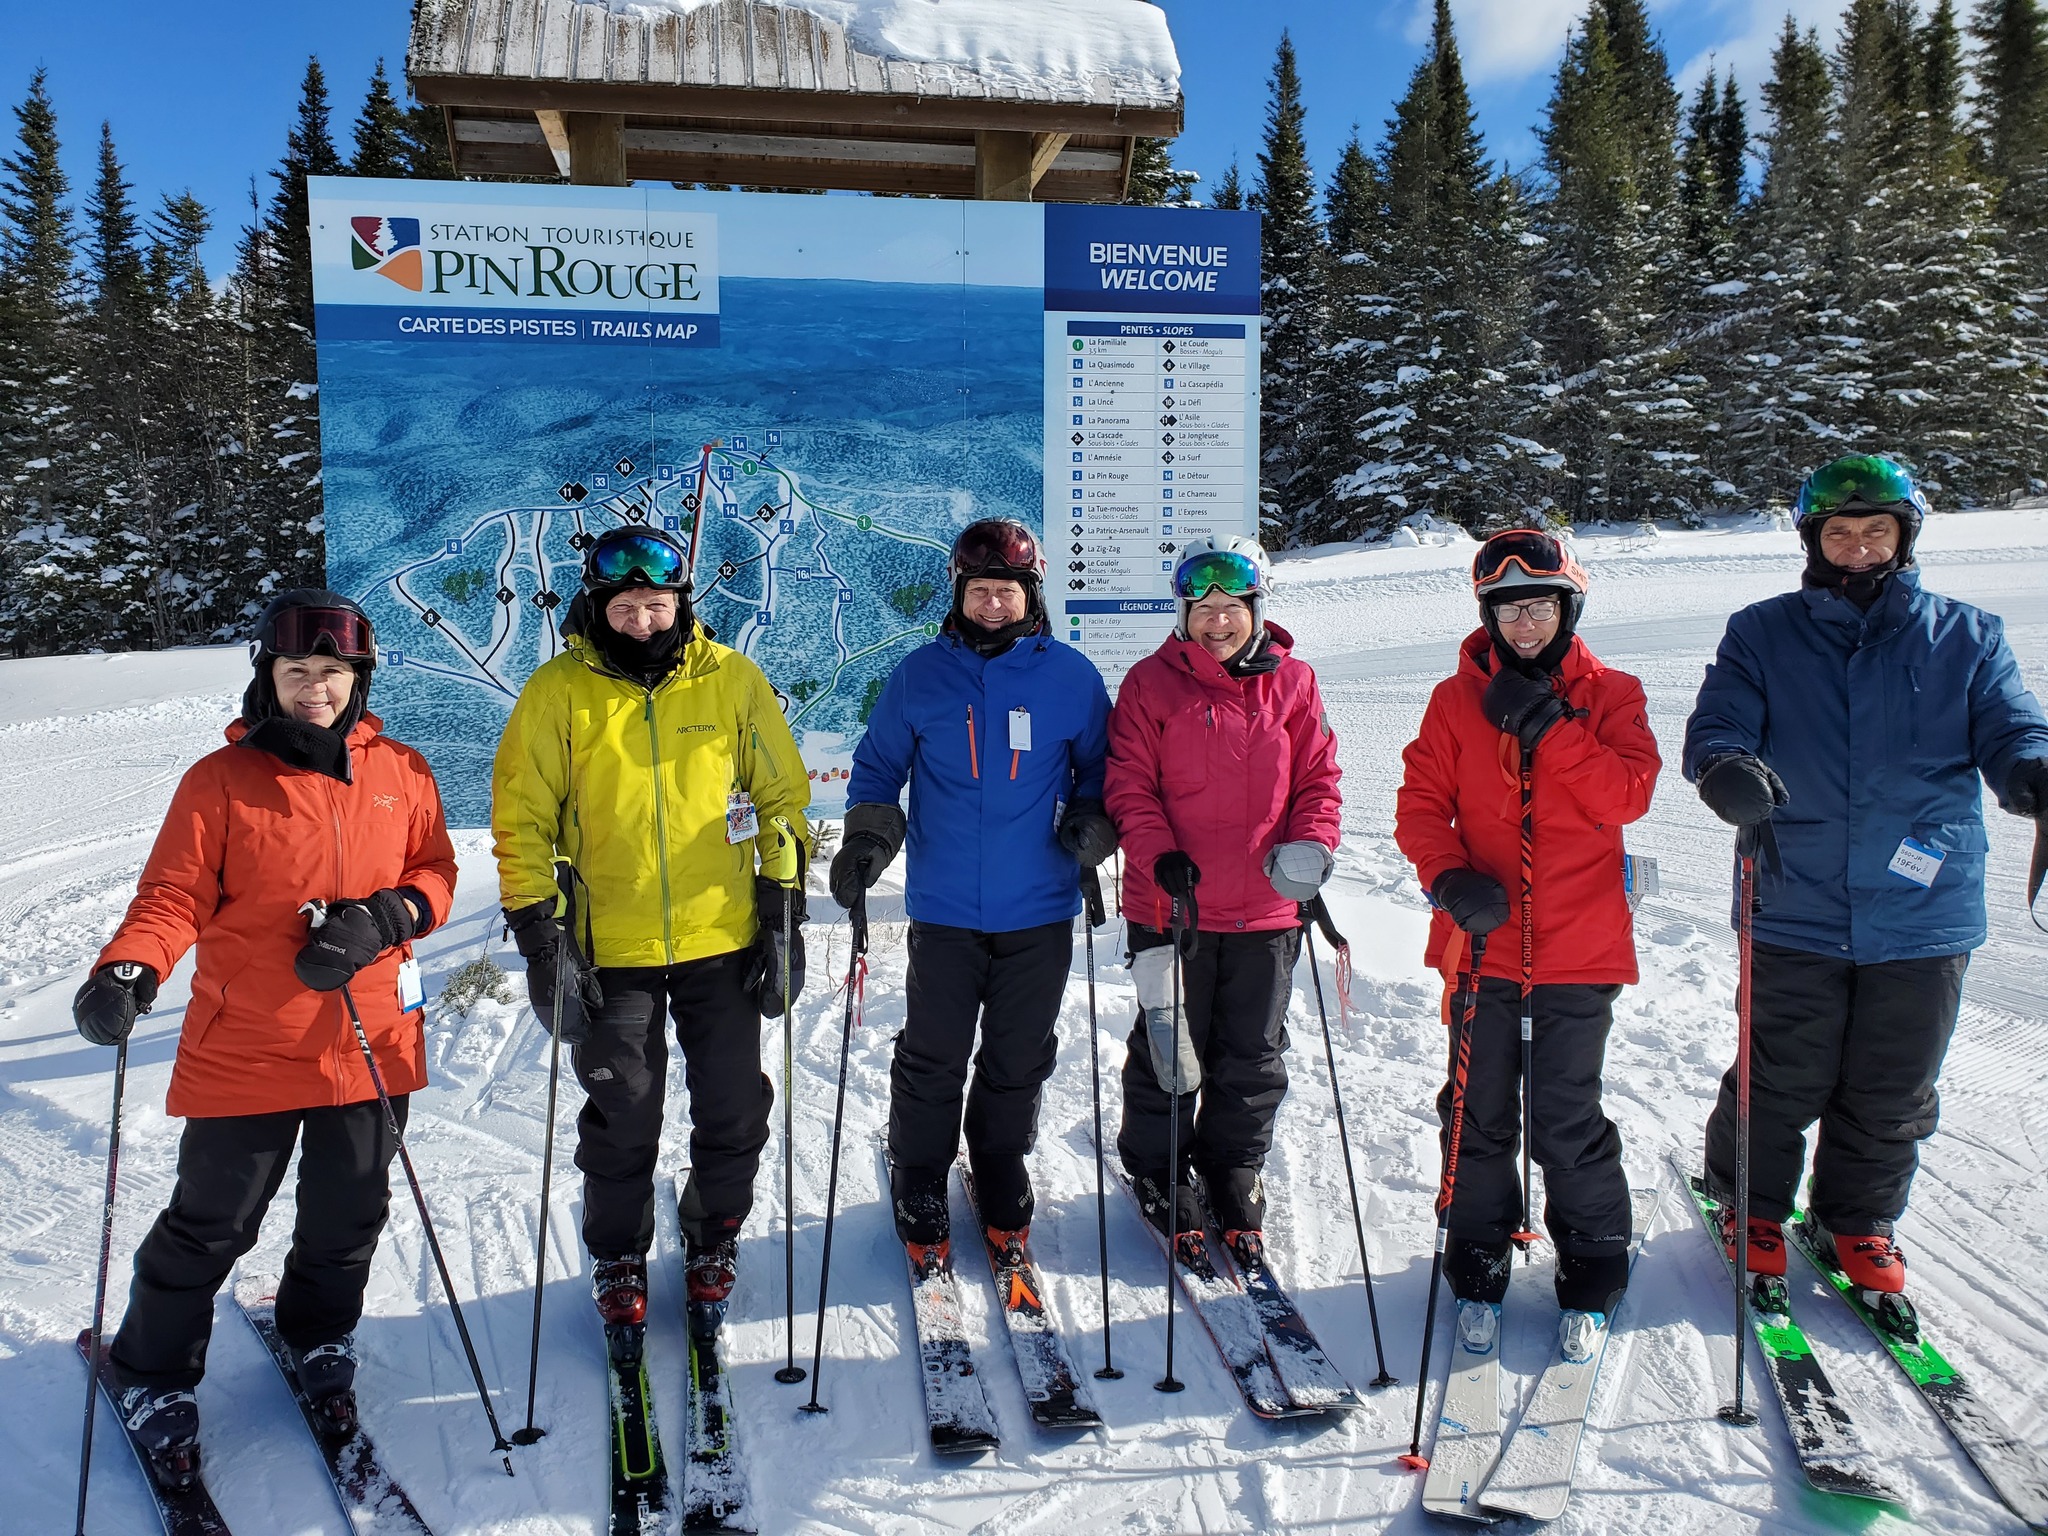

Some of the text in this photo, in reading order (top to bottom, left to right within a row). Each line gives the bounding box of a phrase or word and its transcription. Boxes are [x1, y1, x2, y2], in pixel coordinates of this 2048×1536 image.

[431, 223, 694, 248] STATION TOURISTIQUE
[1090, 243, 1227, 267] BIENVENUE
[1101, 268, 1218, 292] WELCOME
[399, 316, 698, 339] CARTE DES PISTES TRAILS MAP
[1121, 326, 1194, 335] PENTES SLOPES
[1188, 362, 1210, 371] Village
[1188, 381, 1223, 389] Cascapédia
[768, 433, 778, 443] 1B
[736, 440, 745, 449] 1A
[619, 462, 630, 473] 10
[747, 463, 752, 472] 1
[662, 468, 669, 478] 9
[1109, 473, 1128, 481] Rouge
[595, 478, 605, 487] 33
[685, 477, 691, 487] 3
[562, 487, 572, 497] 11
[686, 498, 695, 508] 13
[725, 506, 735, 516] 14
[668, 519, 674, 528] 3
[861, 518, 867, 527] 1
[784, 523, 790, 532] 2
[575, 537, 580, 546] 5
[451, 542, 457, 552] 9
[722, 566, 732, 575] 12
[502, 591, 507, 600] 7
[841, 591, 851, 600] 16
[538, 596, 544, 605] 6
[1120, 602, 1153, 611] LÉGENDE
[427, 614, 434, 623] 8
[761, 614, 767, 624] 2
[928, 625, 934, 634] 1
[1115, 632, 1136, 641] Difficult
[392, 654, 399, 663] 9
[1523, 903, 1532, 965] ROSSIGNOL
[319, 940, 347, 955] Marmot
[352, 1021, 371, 1054] LEKI
[1448, 1109, 1463, 1175] ROSSIGNOL
